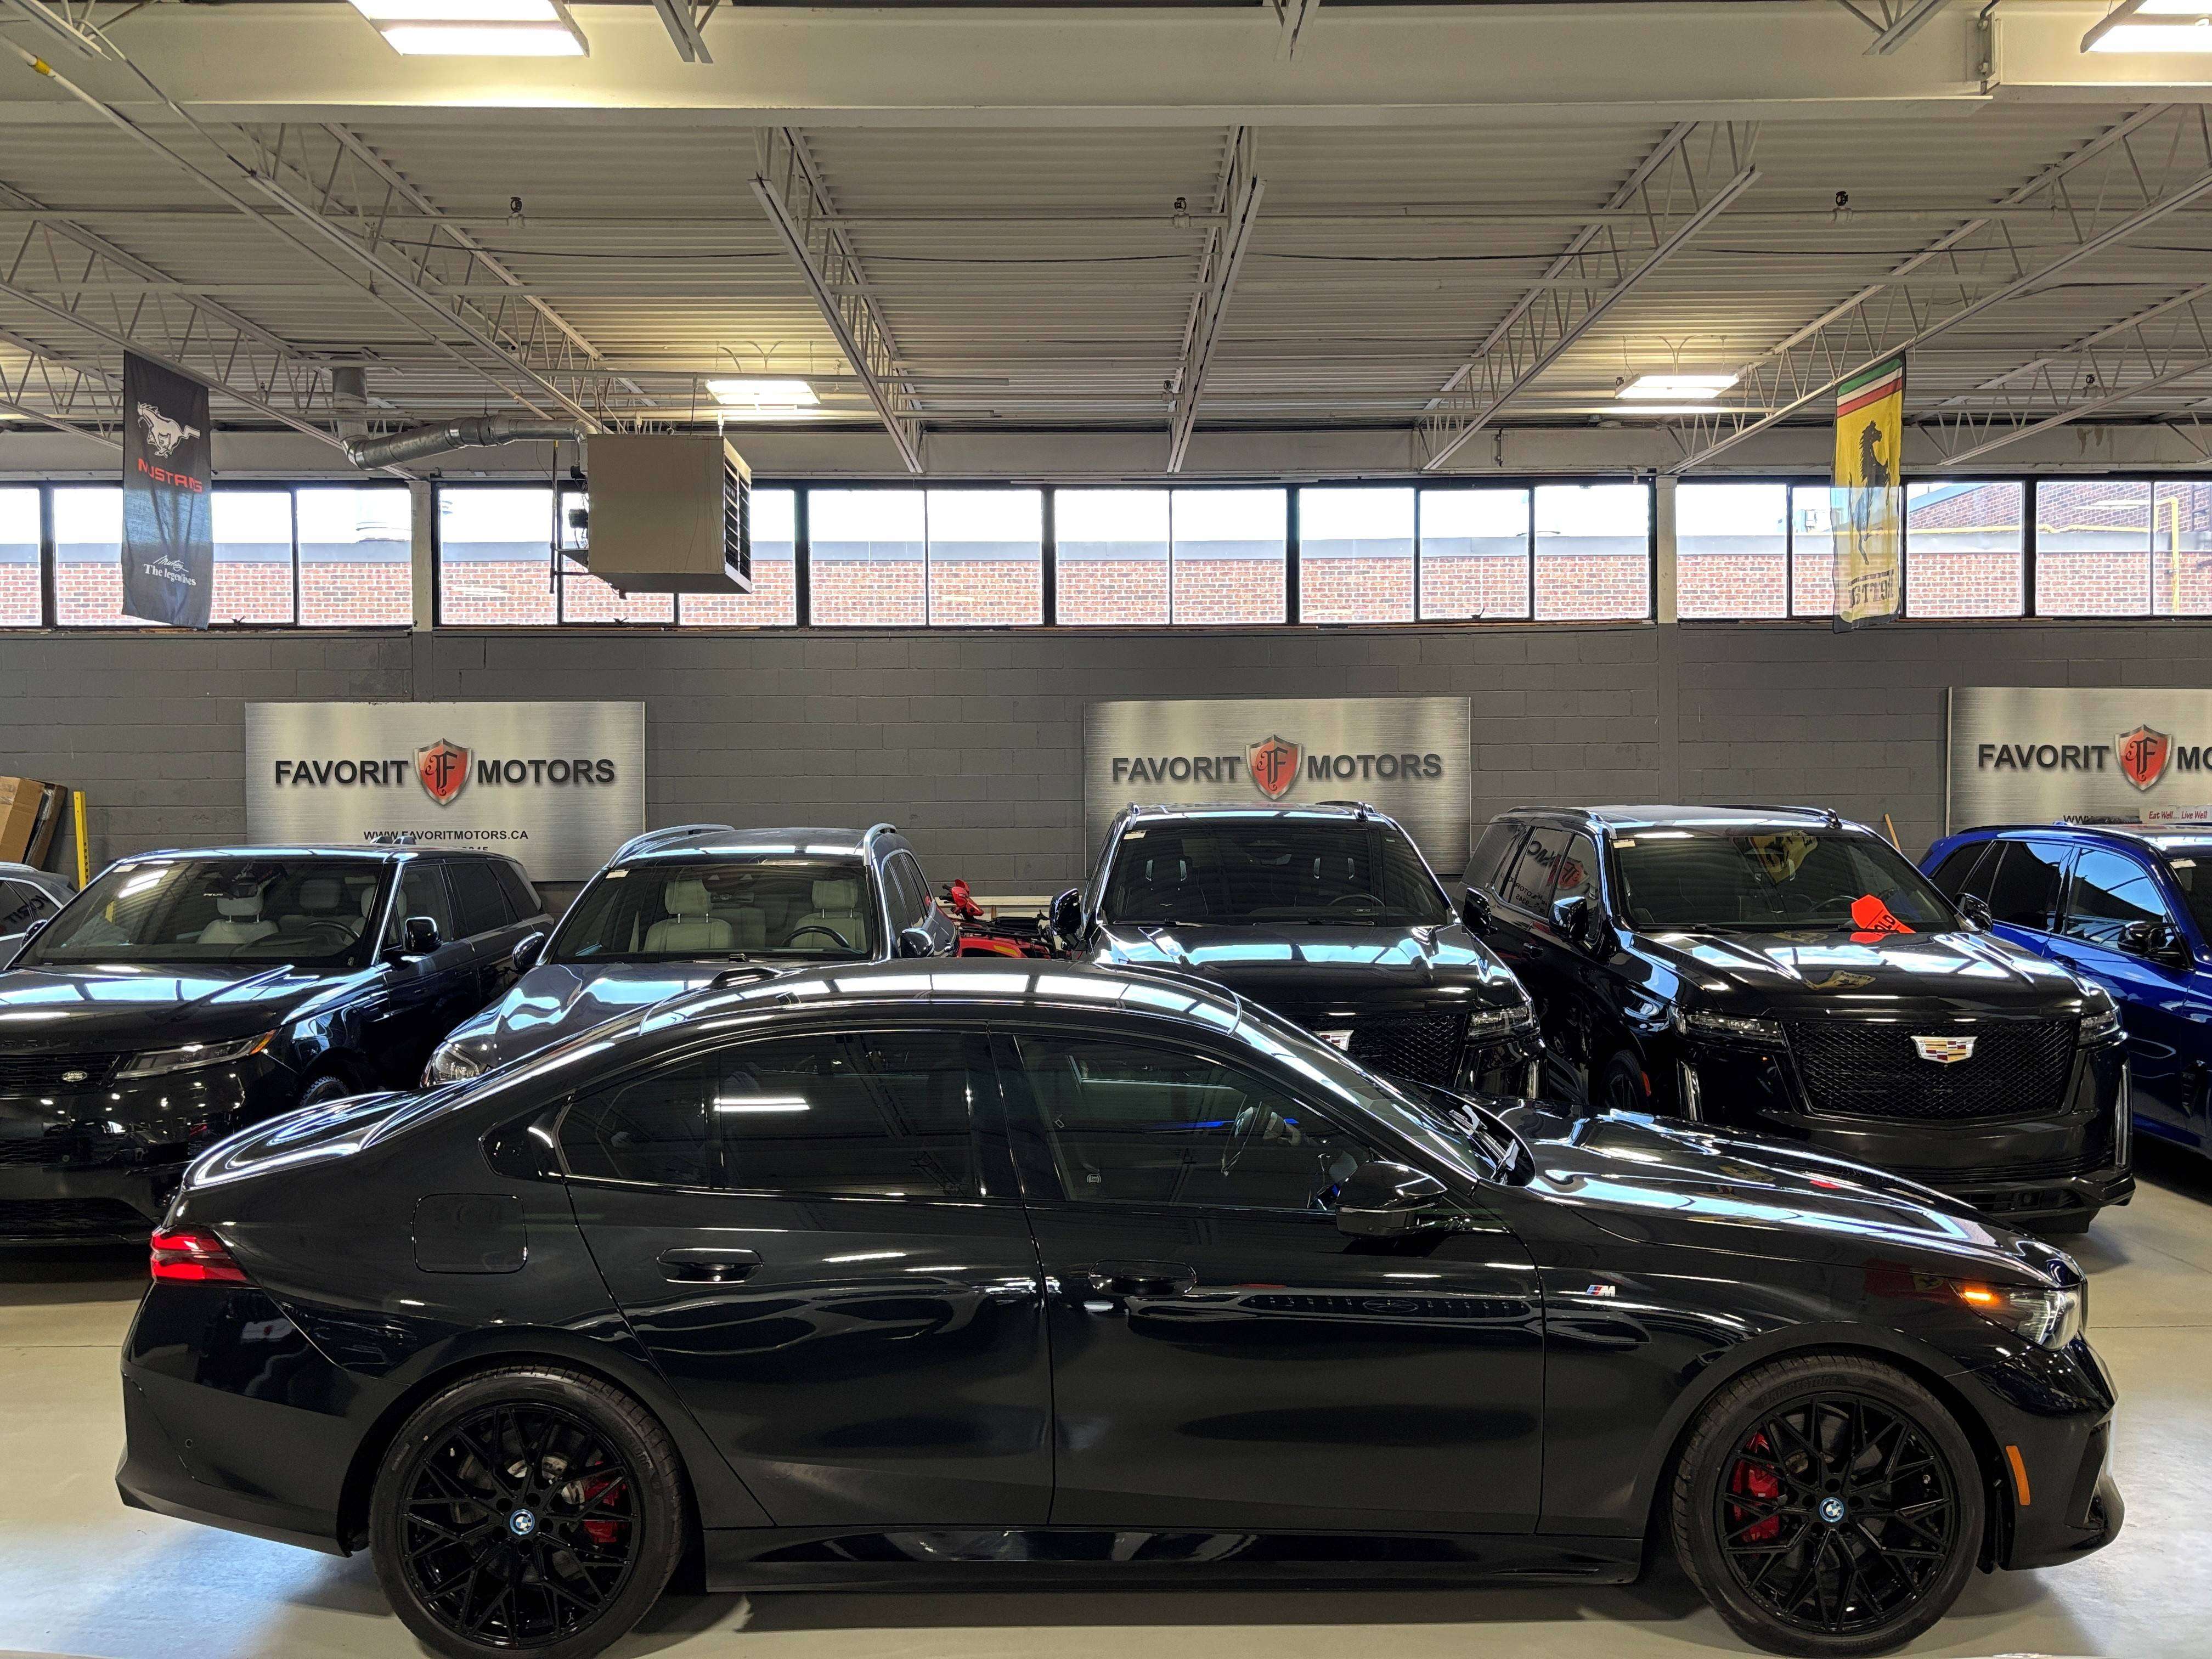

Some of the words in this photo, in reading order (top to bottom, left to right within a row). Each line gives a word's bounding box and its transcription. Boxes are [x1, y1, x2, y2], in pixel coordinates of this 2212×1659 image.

[143, 563, 163, 577] The
[1978, 744, 2109, 769] FAVORIT
[275, 760, 409, 785] FAVORIT
[478, 759, 614, 783] MOTORS
[1112, 756, 1241, 782] FAVORIT
[1308, 754, 1442, 778] MOTORS
[2148, 811, 2160, 819] Eat
[2181, 811, 2193, 819] Live
[2194, 810, 2208, 819] Well
[363, 830, 529, 840] WWWFAVORITMOTORS.CA
[1874, 914, 1896, 930] OLD
